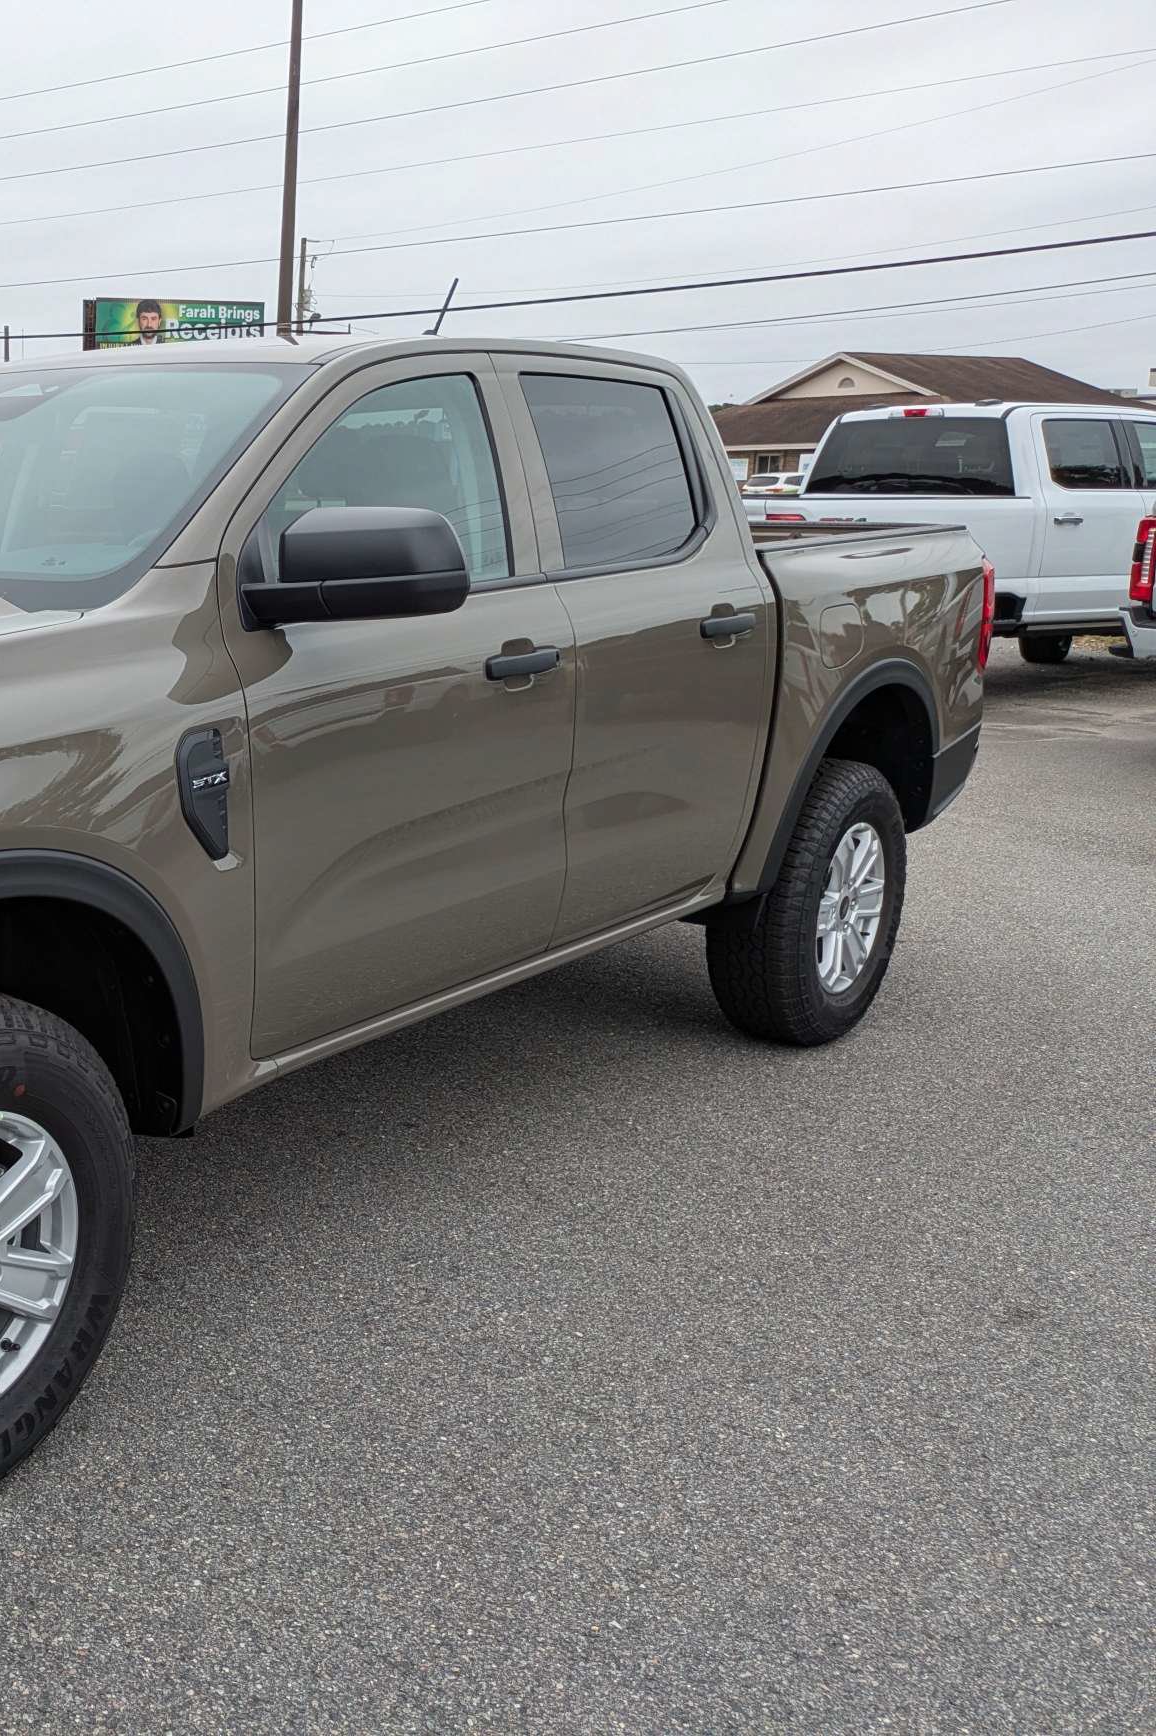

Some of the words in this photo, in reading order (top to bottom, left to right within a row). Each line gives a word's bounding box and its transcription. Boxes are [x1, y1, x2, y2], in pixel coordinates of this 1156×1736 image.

[179, 305, 216, 319] Farah
[218, 306, 261, 322] Brings
[192, 771, 228, 789] STX
